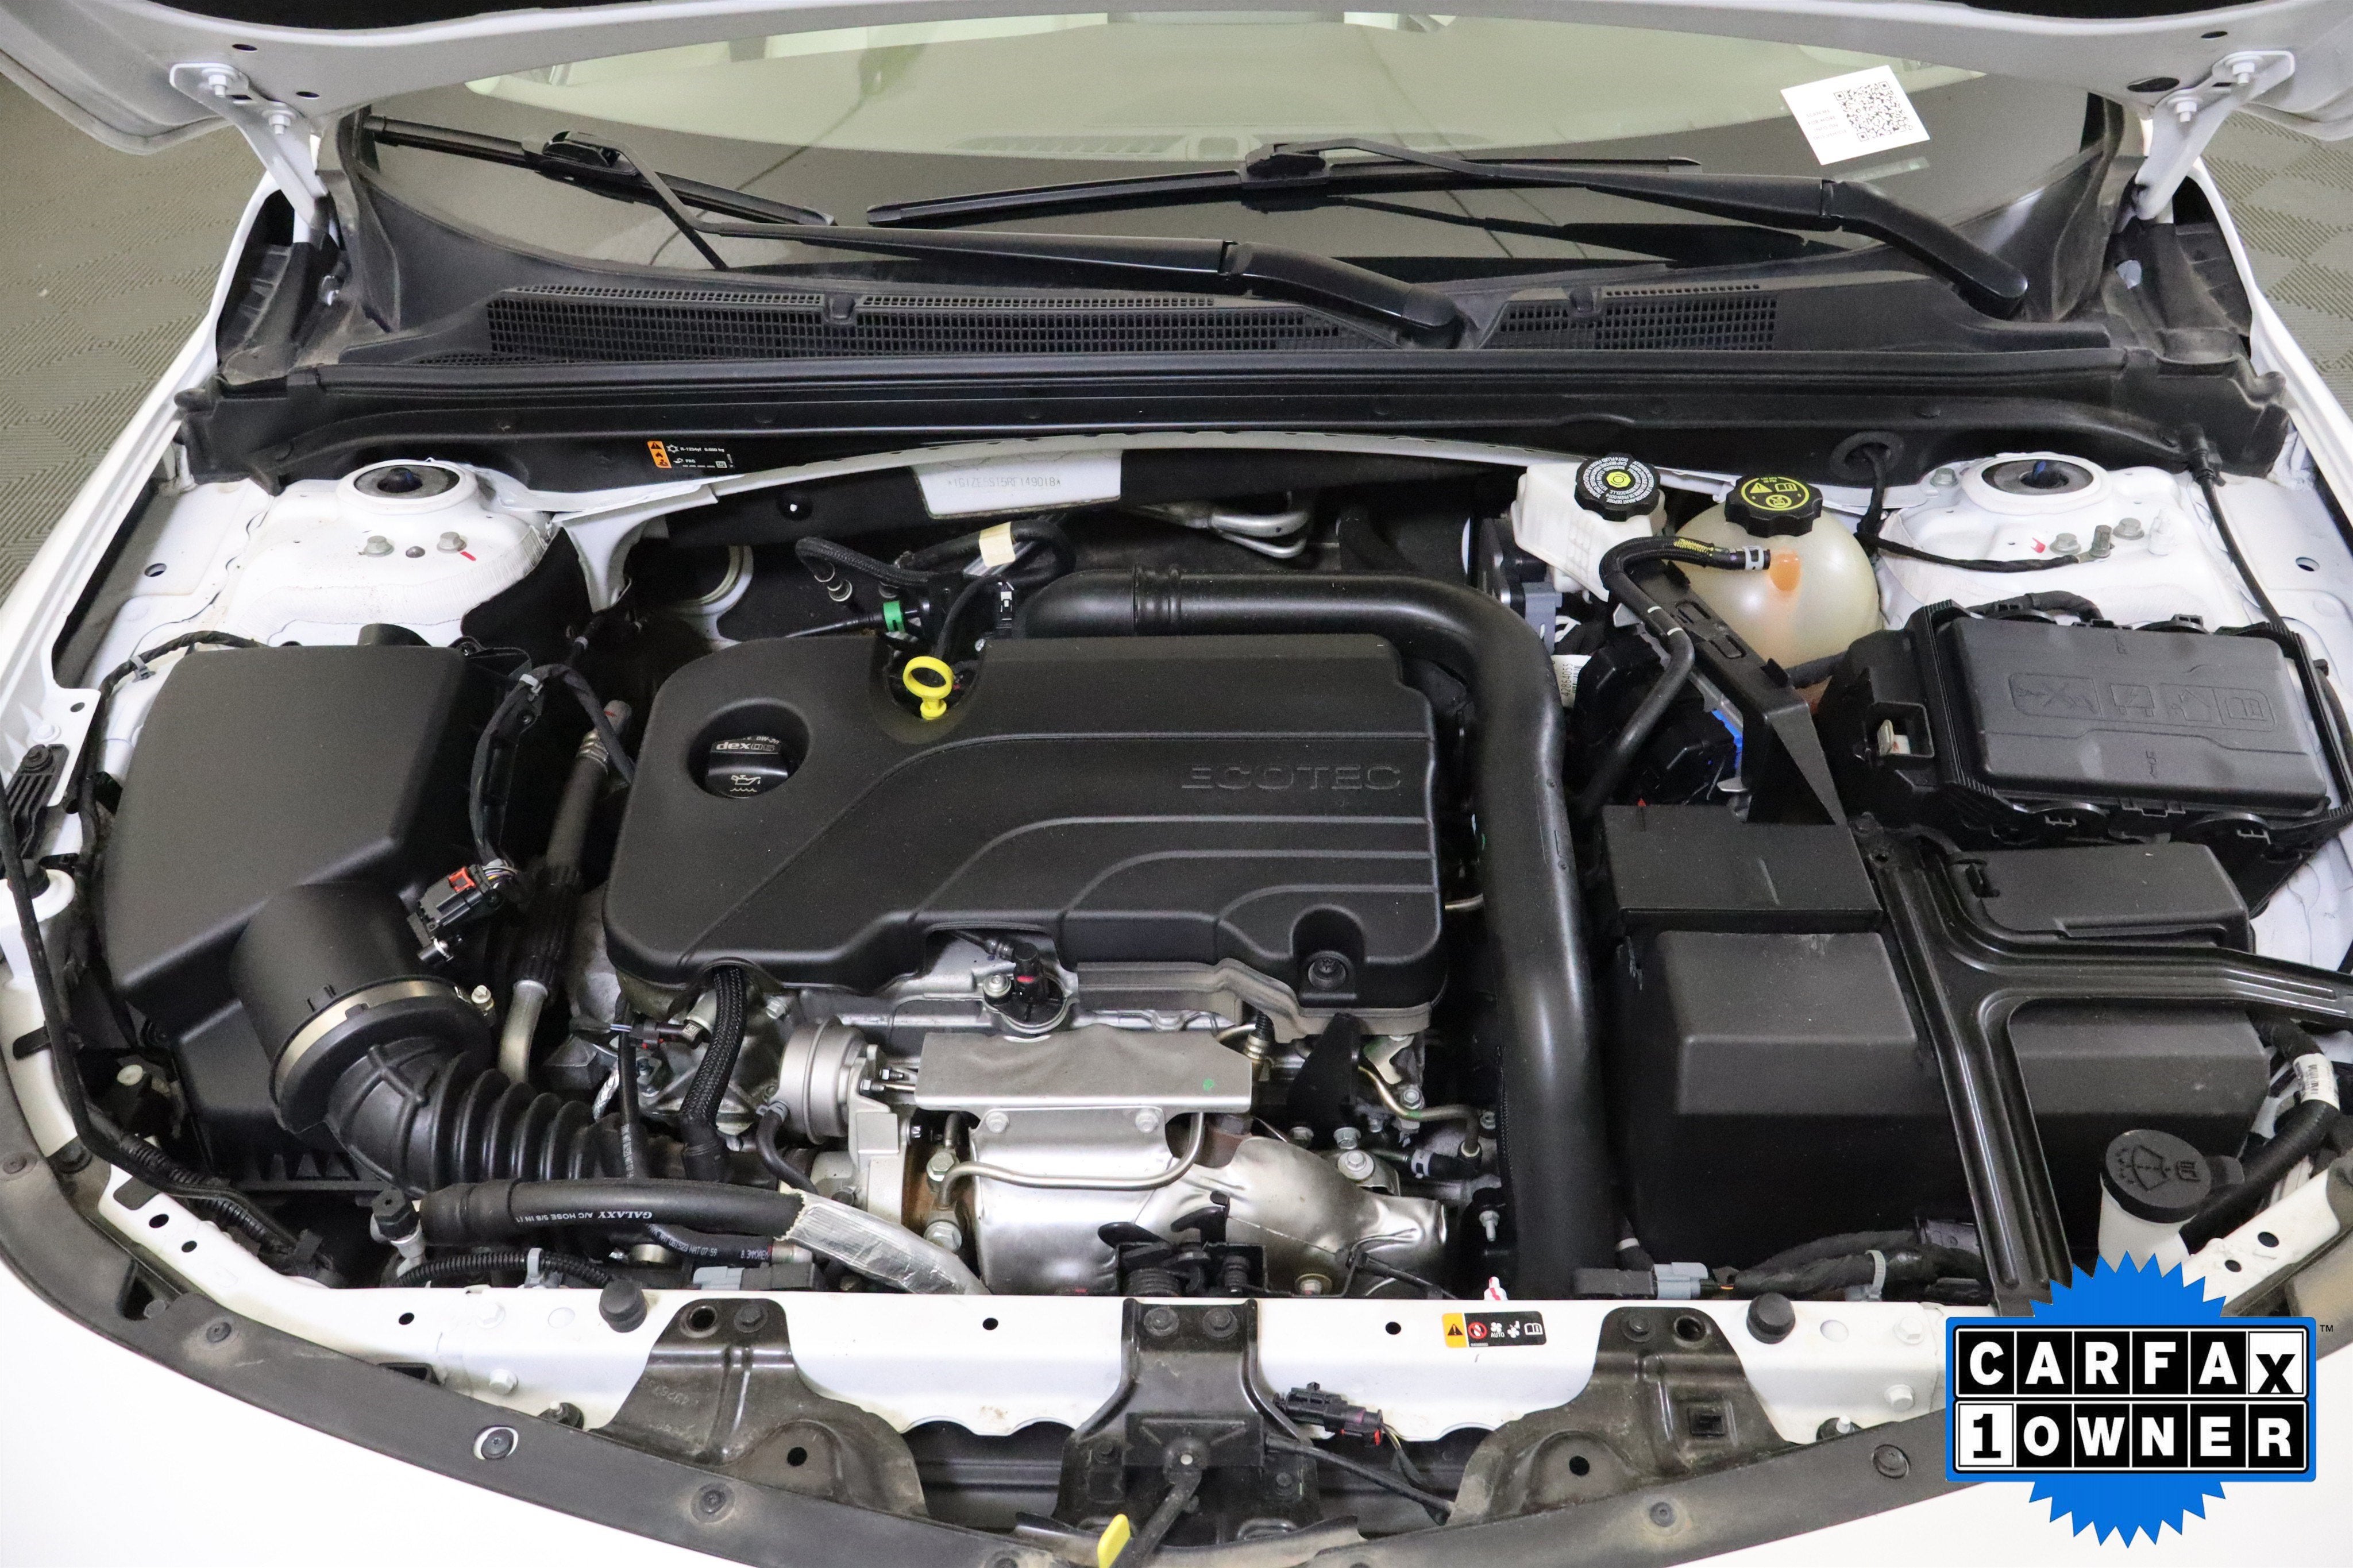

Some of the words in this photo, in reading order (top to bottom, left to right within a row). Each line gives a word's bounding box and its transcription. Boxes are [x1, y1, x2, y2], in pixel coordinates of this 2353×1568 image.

[1561, 663, 1573, 697] 42864055
[716, 742, 776, 751] dexos
[1182, 766, 1401, 790] ECOTEC
[598, 1211, 653, 1219] GALAXY
